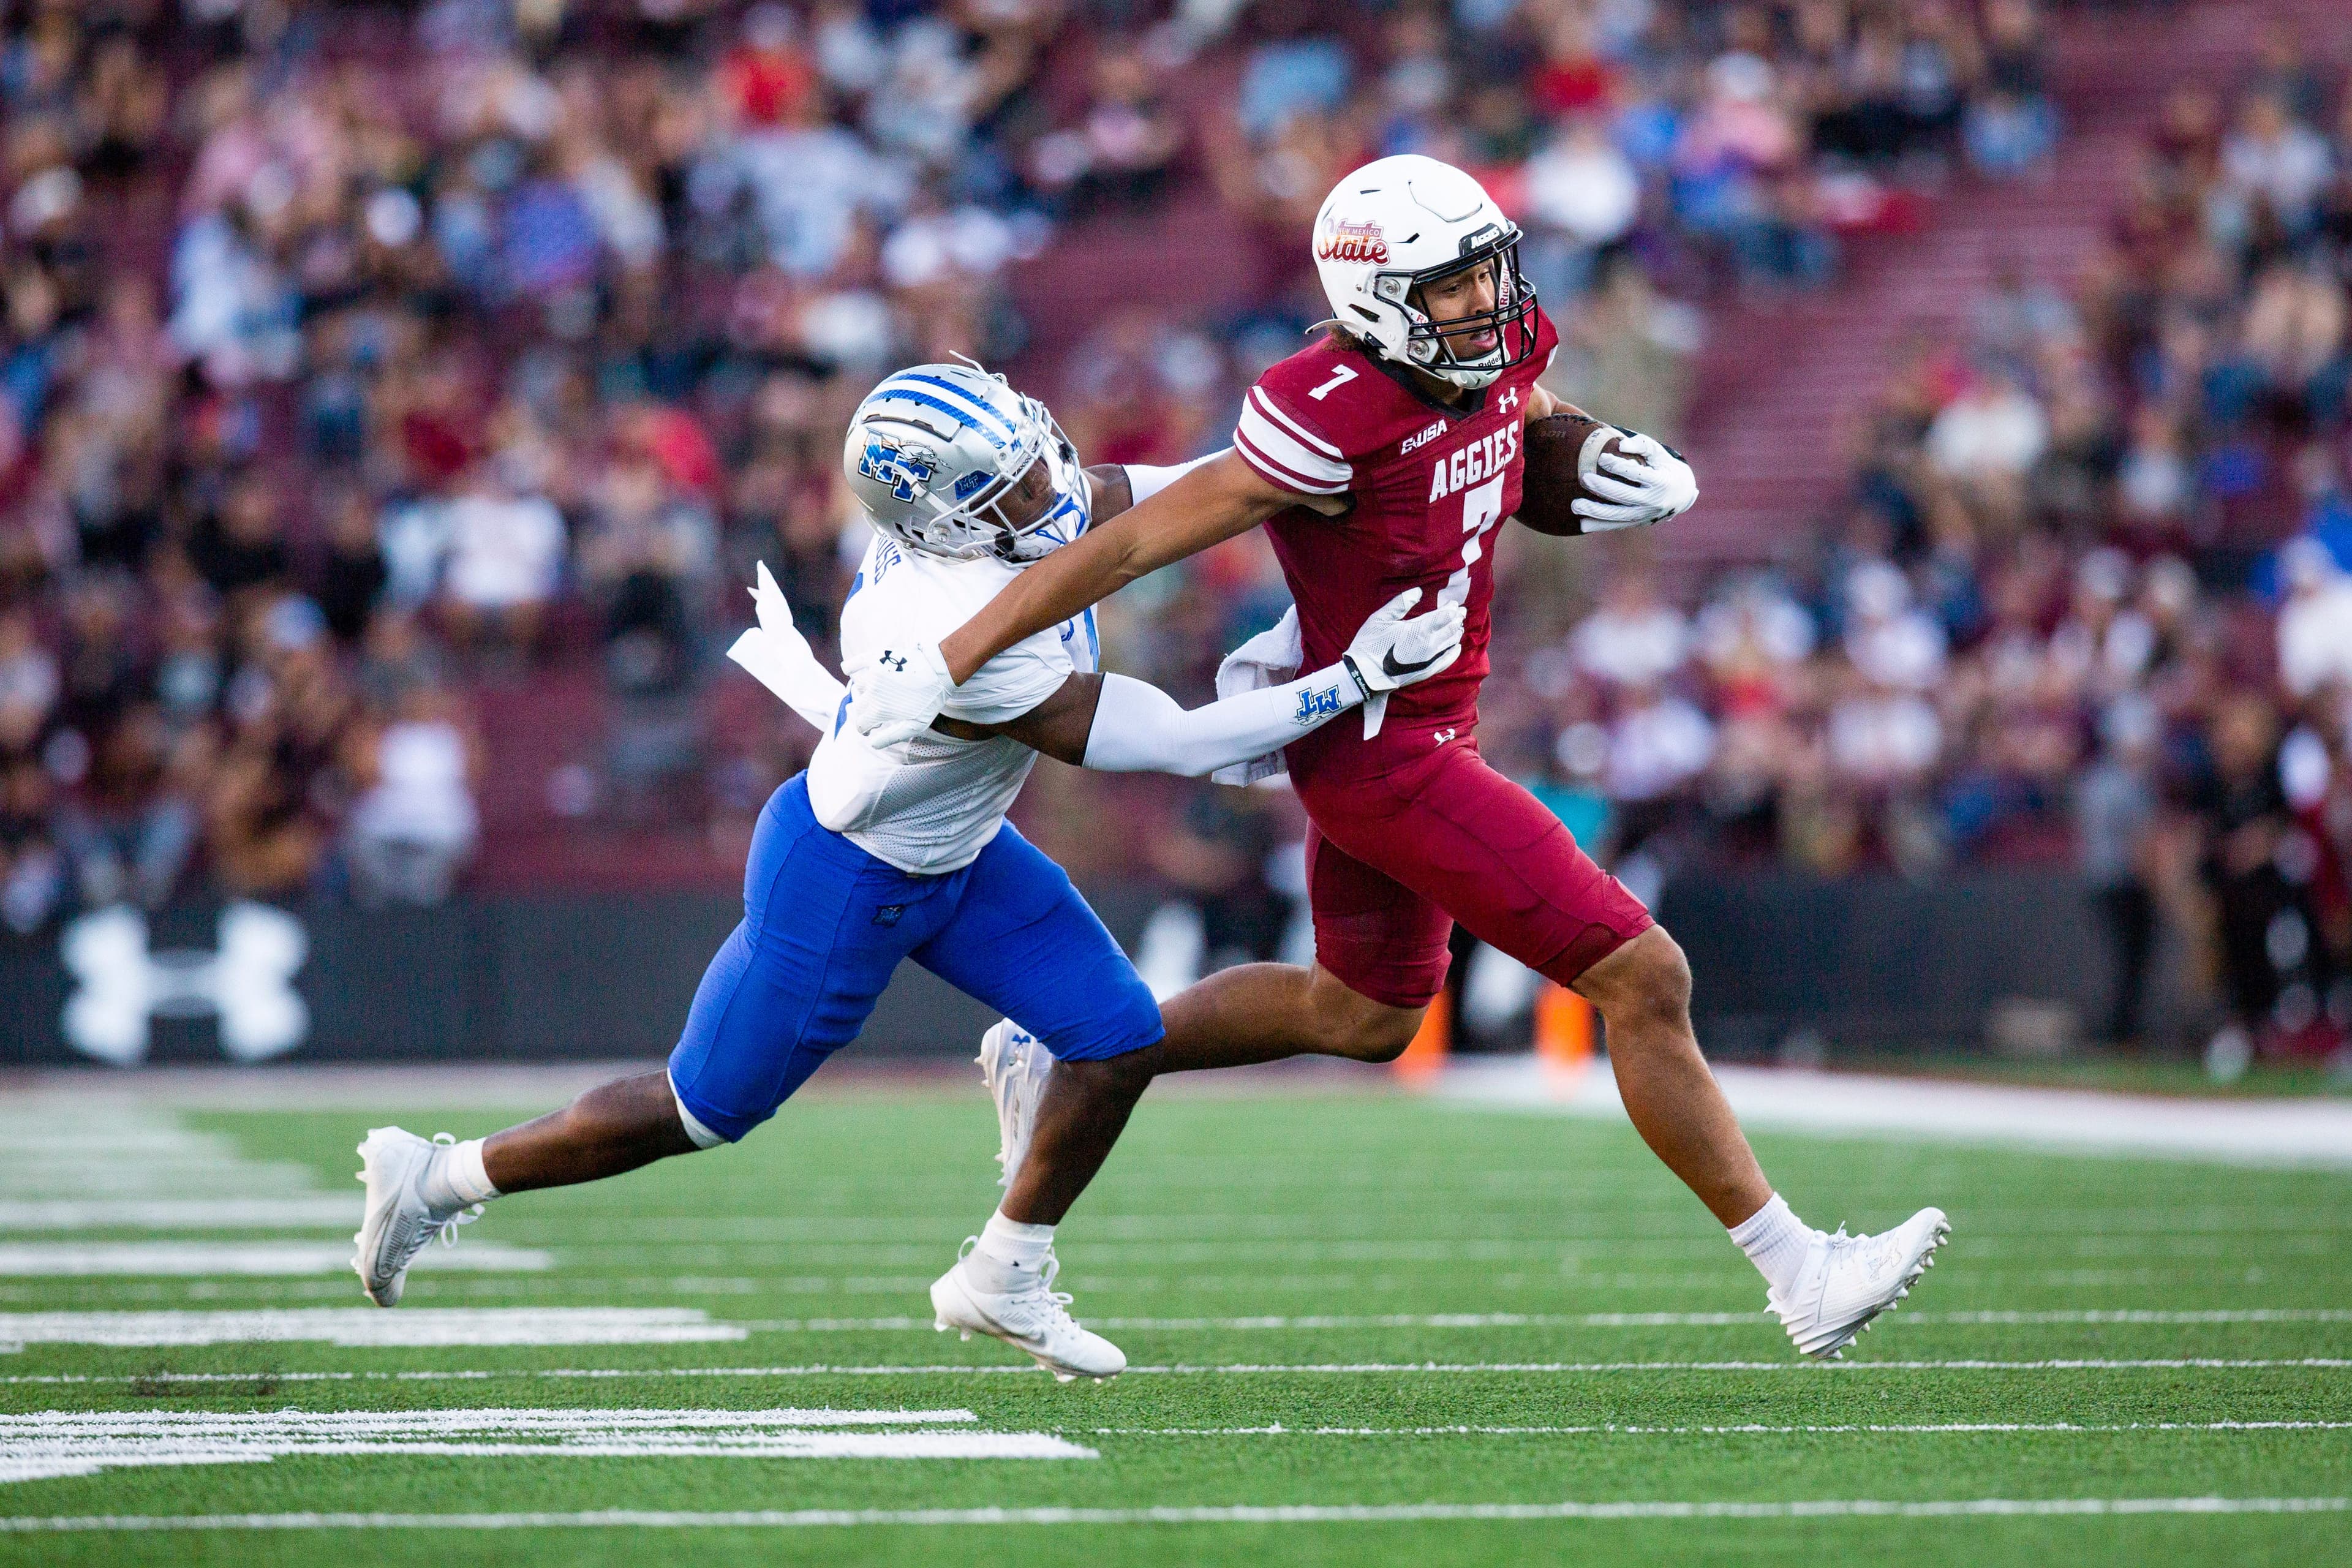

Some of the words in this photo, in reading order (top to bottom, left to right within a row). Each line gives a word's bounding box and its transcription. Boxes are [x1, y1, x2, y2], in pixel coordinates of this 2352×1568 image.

[1317, 217, 1389, 265] State
[1338, 227, 1350, 236] NEW
[1352, 228, 1380, 237] MEXICO
[1499, 268, 1510, 306] Riddell
[1308, 364, 1359, 401] 7
[1429, 420, 1519, 504] AGGIES
[1437, 470, 1505, 610] 7
